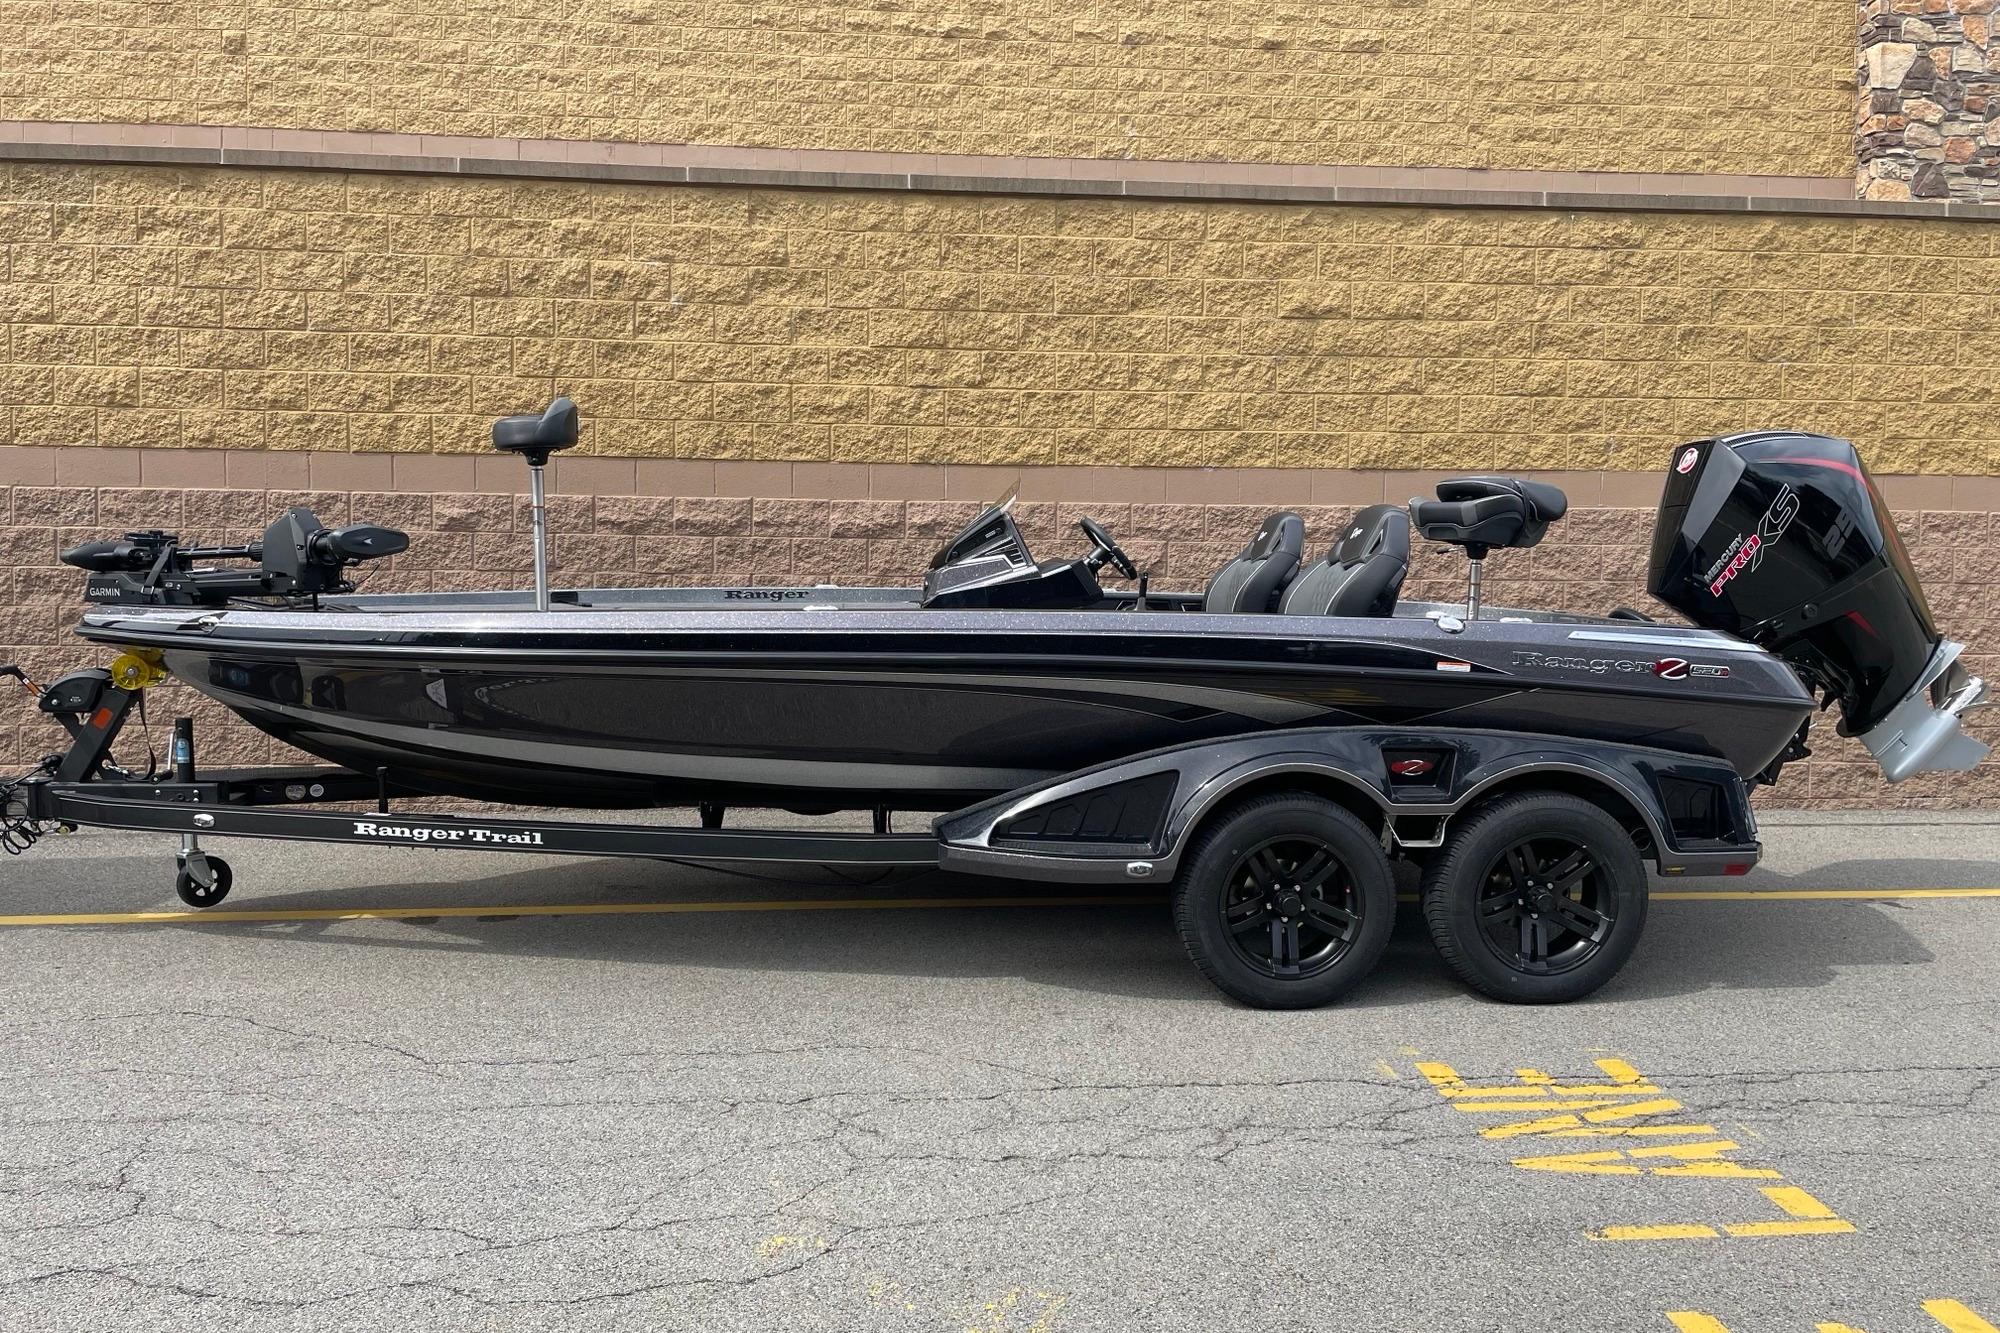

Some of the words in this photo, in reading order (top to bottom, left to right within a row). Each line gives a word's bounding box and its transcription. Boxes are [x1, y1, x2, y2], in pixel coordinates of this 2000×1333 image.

[1710, 534, 1761, 597] PRO
[1751, 483, 1800, 573] XS
[1704, 533, 1743, 582] MERCURY
[89, 587, 120, 597] GARMIN
[724, 590, 809, 602] Ranger
[1512, 650, 1657, 674] Ranger
[353, 822, 464, 841] Ranger
[468, 829, 544, 845] Trail
[1414, 1059, 1857, 1241] LANE
